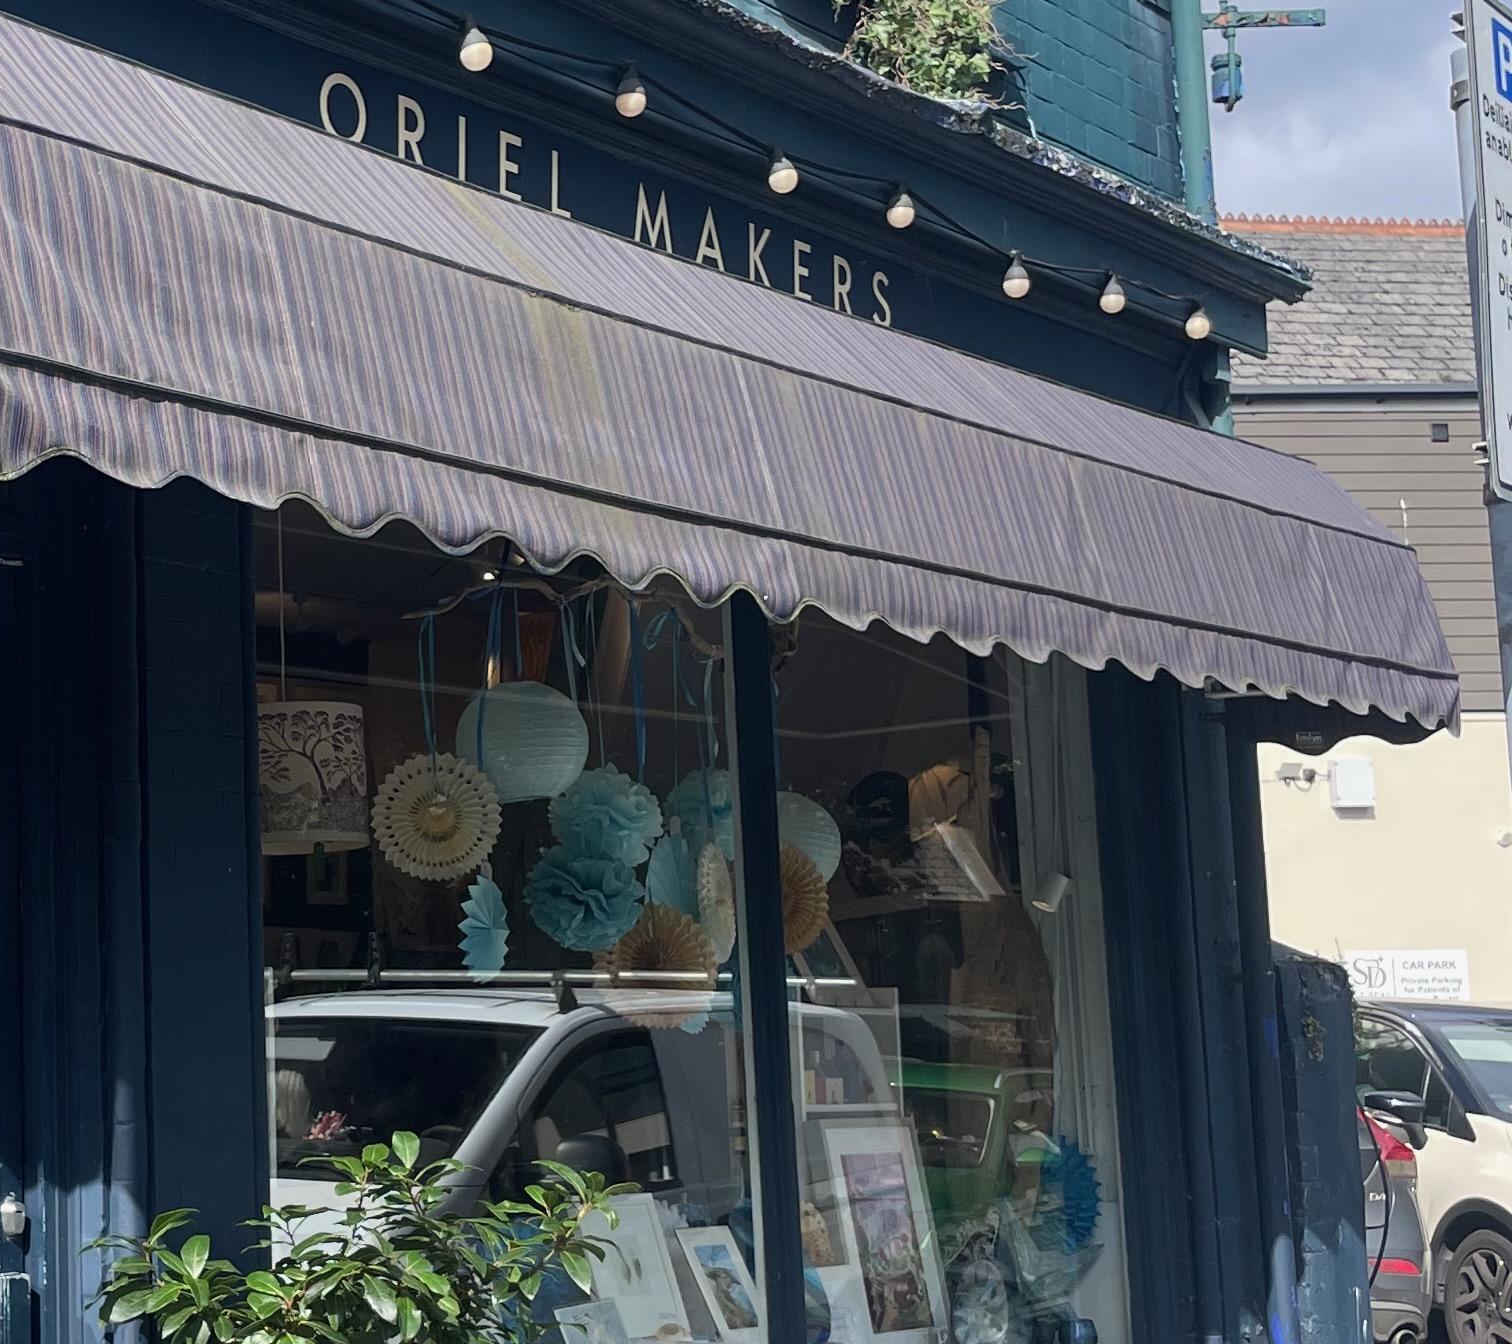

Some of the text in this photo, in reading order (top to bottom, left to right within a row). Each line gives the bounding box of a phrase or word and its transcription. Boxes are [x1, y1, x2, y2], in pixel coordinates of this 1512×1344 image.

[319, 72, 892, 328] ORIEL MAKERS
[1402, 960, 1457, 969] CAR PARK
